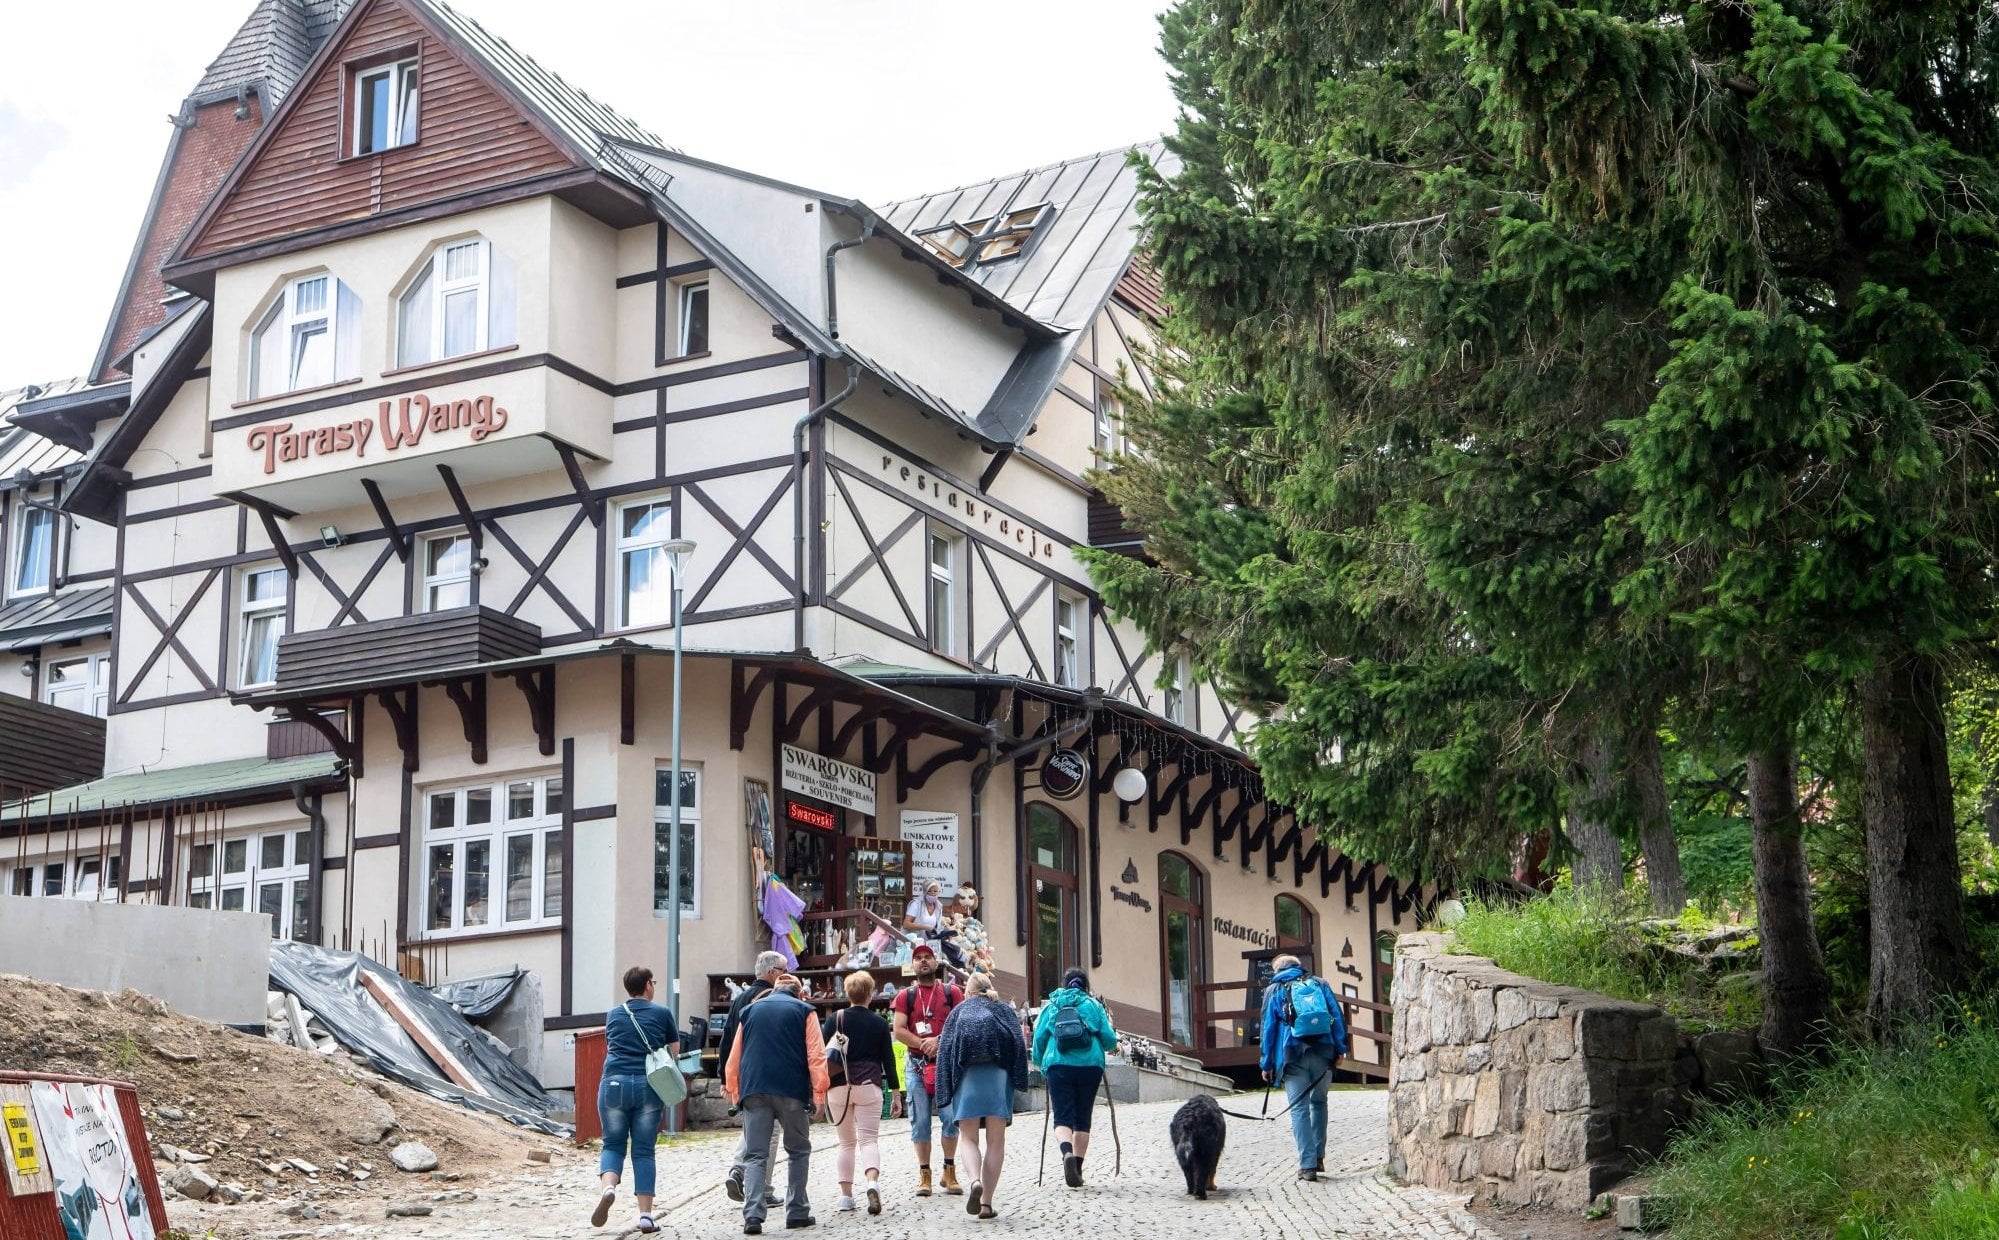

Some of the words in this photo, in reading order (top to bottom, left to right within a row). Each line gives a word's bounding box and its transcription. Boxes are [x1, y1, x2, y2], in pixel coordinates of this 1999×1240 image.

[247, 418, 373, 474] Tarasy
[379, 394, 508, 441] Wang
[786, 748, 872, 788] SWAROVSKI
[809, 785, 852, 806] SOUVENIRS
[841, 786, 874, 803] PORCELANA
[791, 804, 832, 827] Swarovski
[904, 832, 954, 842] UNIKATOWE
[1213, 916, 1277, 950] restauracja
